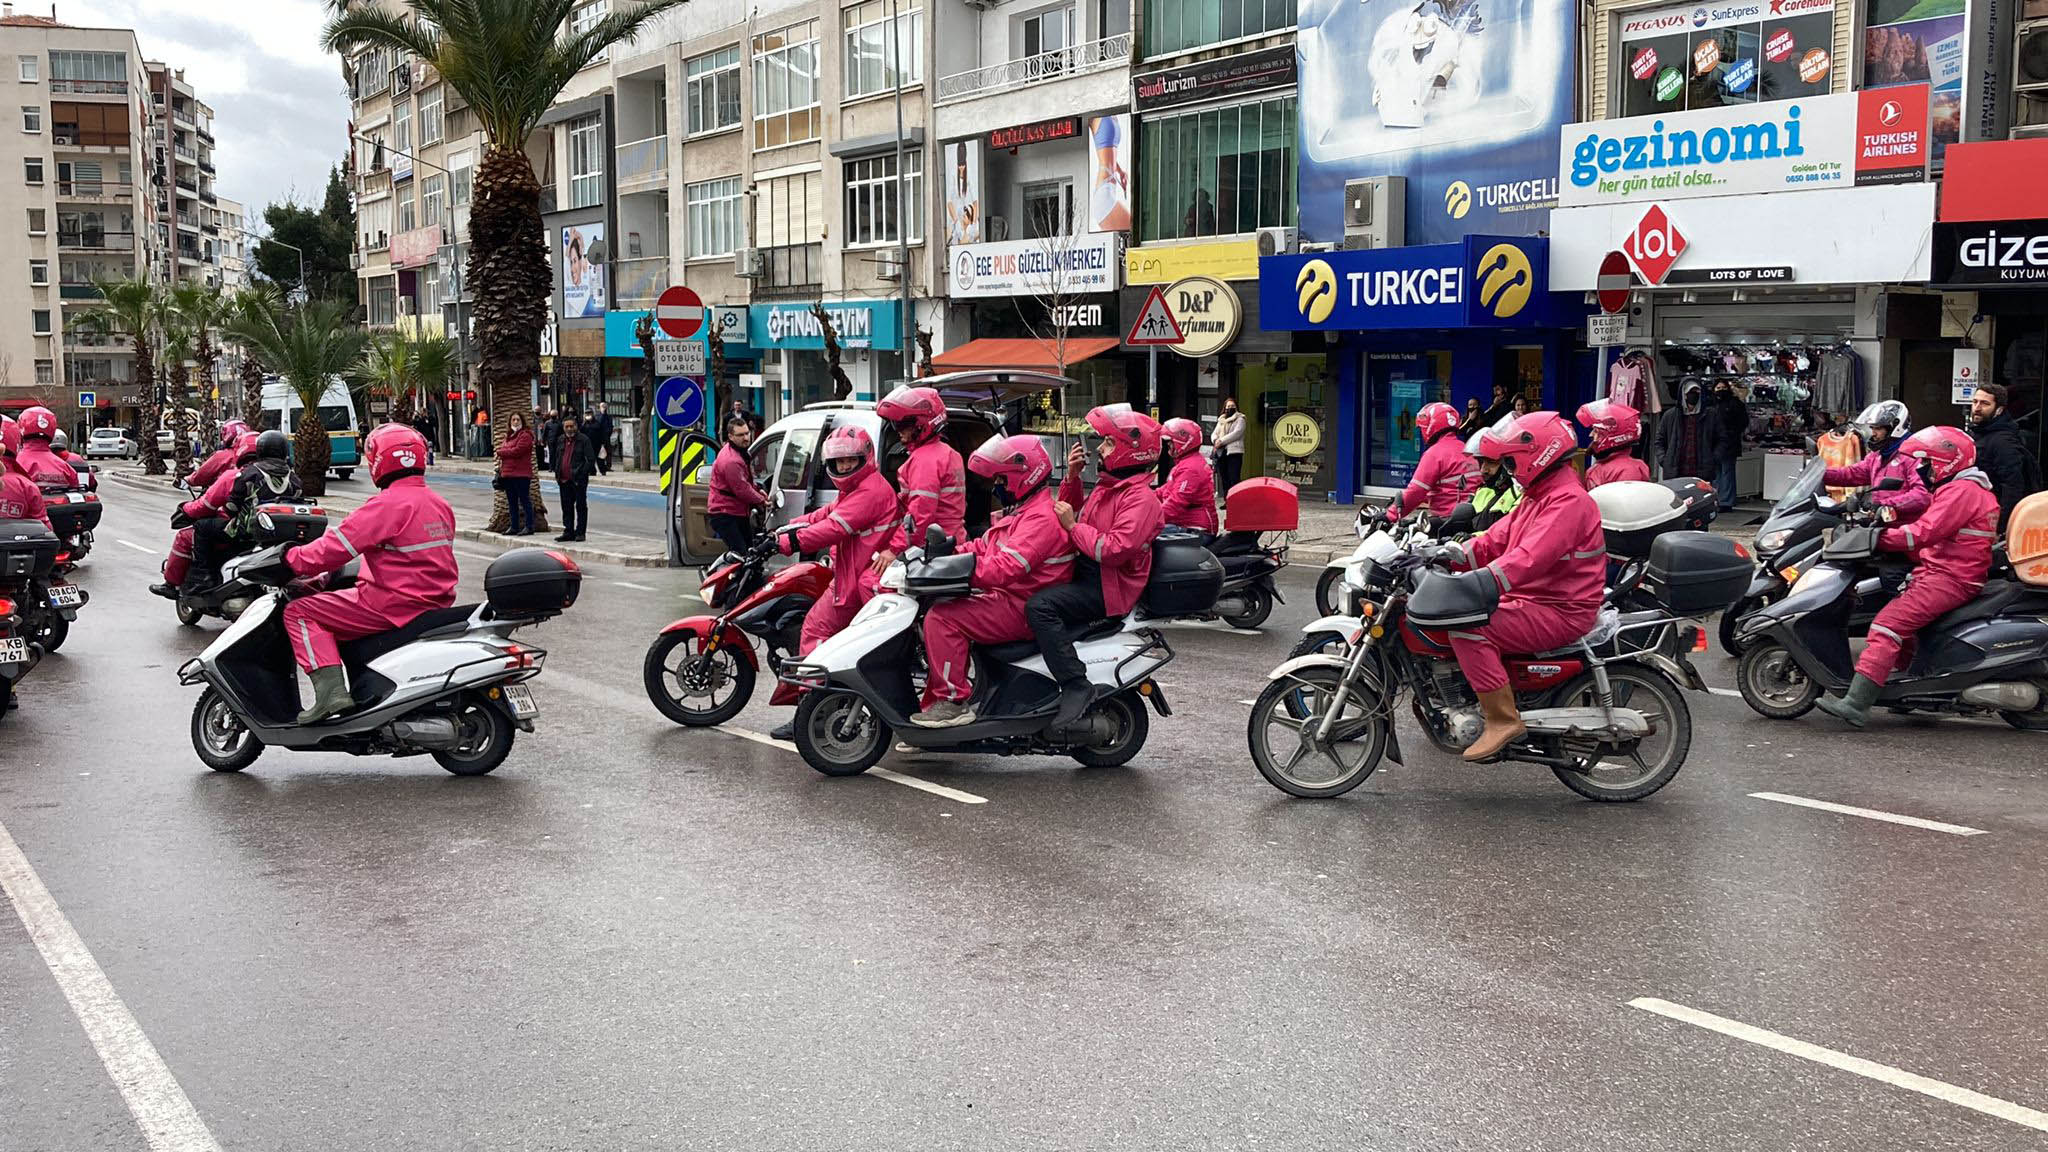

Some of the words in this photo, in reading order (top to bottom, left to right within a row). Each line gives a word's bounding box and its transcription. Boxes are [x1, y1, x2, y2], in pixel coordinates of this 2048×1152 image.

[1711, 5, 1759, 22] SunExpress
[1625, 14, 1686, 33] PEGASUS
[1570, 105, 1804, 187] gezinomi
[1863, 131, 1917, 146] TURKISH
[1862, 143, 1917, 158] AIRLINES
[1791, 163, 1818, 174] Golden
[1819, 163, 1829, 172] Of
[1830, 162, 1841, 171] Tur
[1476, 177, 1559, 207] TURKCELL
[1598, 178, 1618, 193] her
[1622, 175, 1647, 196] gün
[1651, 171, 1680, 188] tatil
[1634, 218, 1677, 260] lol
[976, 256, 992, 276] EGE
[994, 253, 1016, 276] PLUS
[1018, 249, 1060, 274] GÜZELLK
[1063, 242, 1106, 271] MERKEZİ
[1710, 270, 1736, 280] LOTS
[1738, 270, 1752, 279] OF
[1757, 269, 1785, 278] LOVE
[2001, 268, 2048, 279] KUYUM
[784, 307, 870, 338] FİNANEVİM
[1178, 318, 1225, 337] erfumum
[122, 395, 140, 404] FIR
[59, 595, 75, 604] 604
